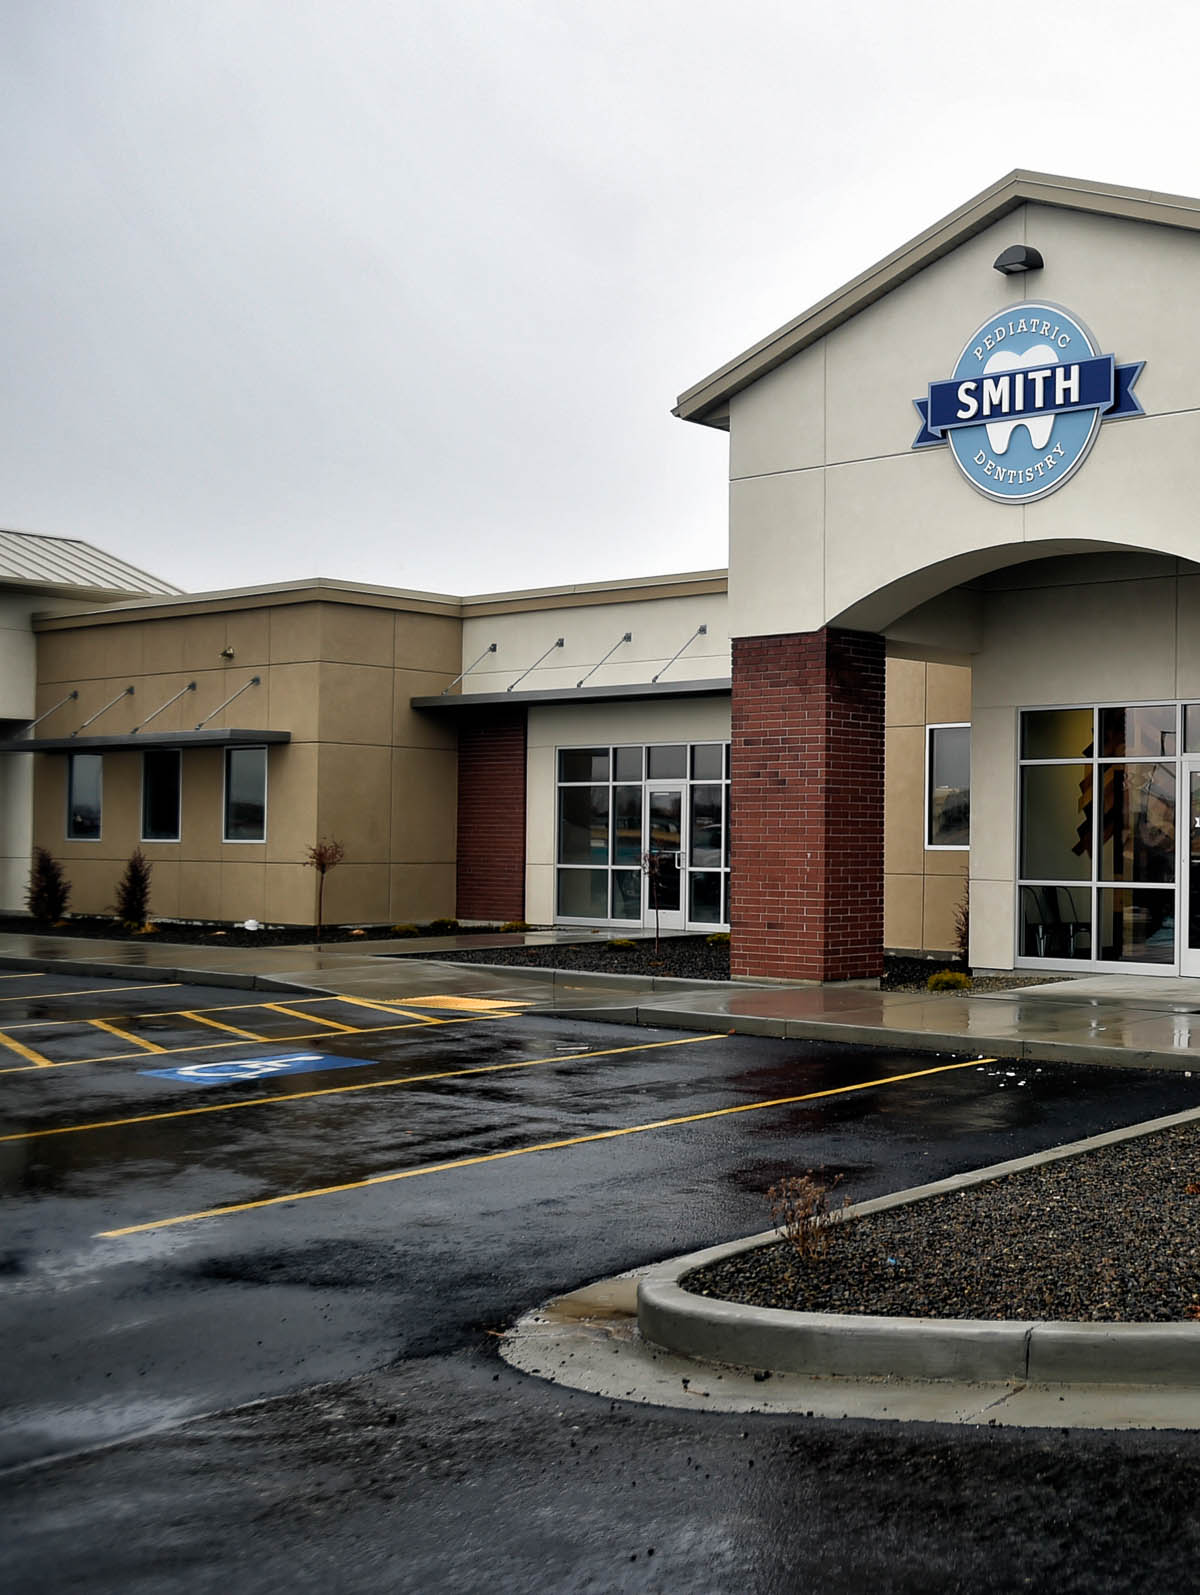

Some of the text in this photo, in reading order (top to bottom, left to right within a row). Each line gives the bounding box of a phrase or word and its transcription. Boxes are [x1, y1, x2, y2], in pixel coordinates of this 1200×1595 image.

[973, 318, 1070, 361] PEDIATRIC
[956, 364, 1080, 419] SMITH
[973, 442, 1065, 484] DENTISTRY
